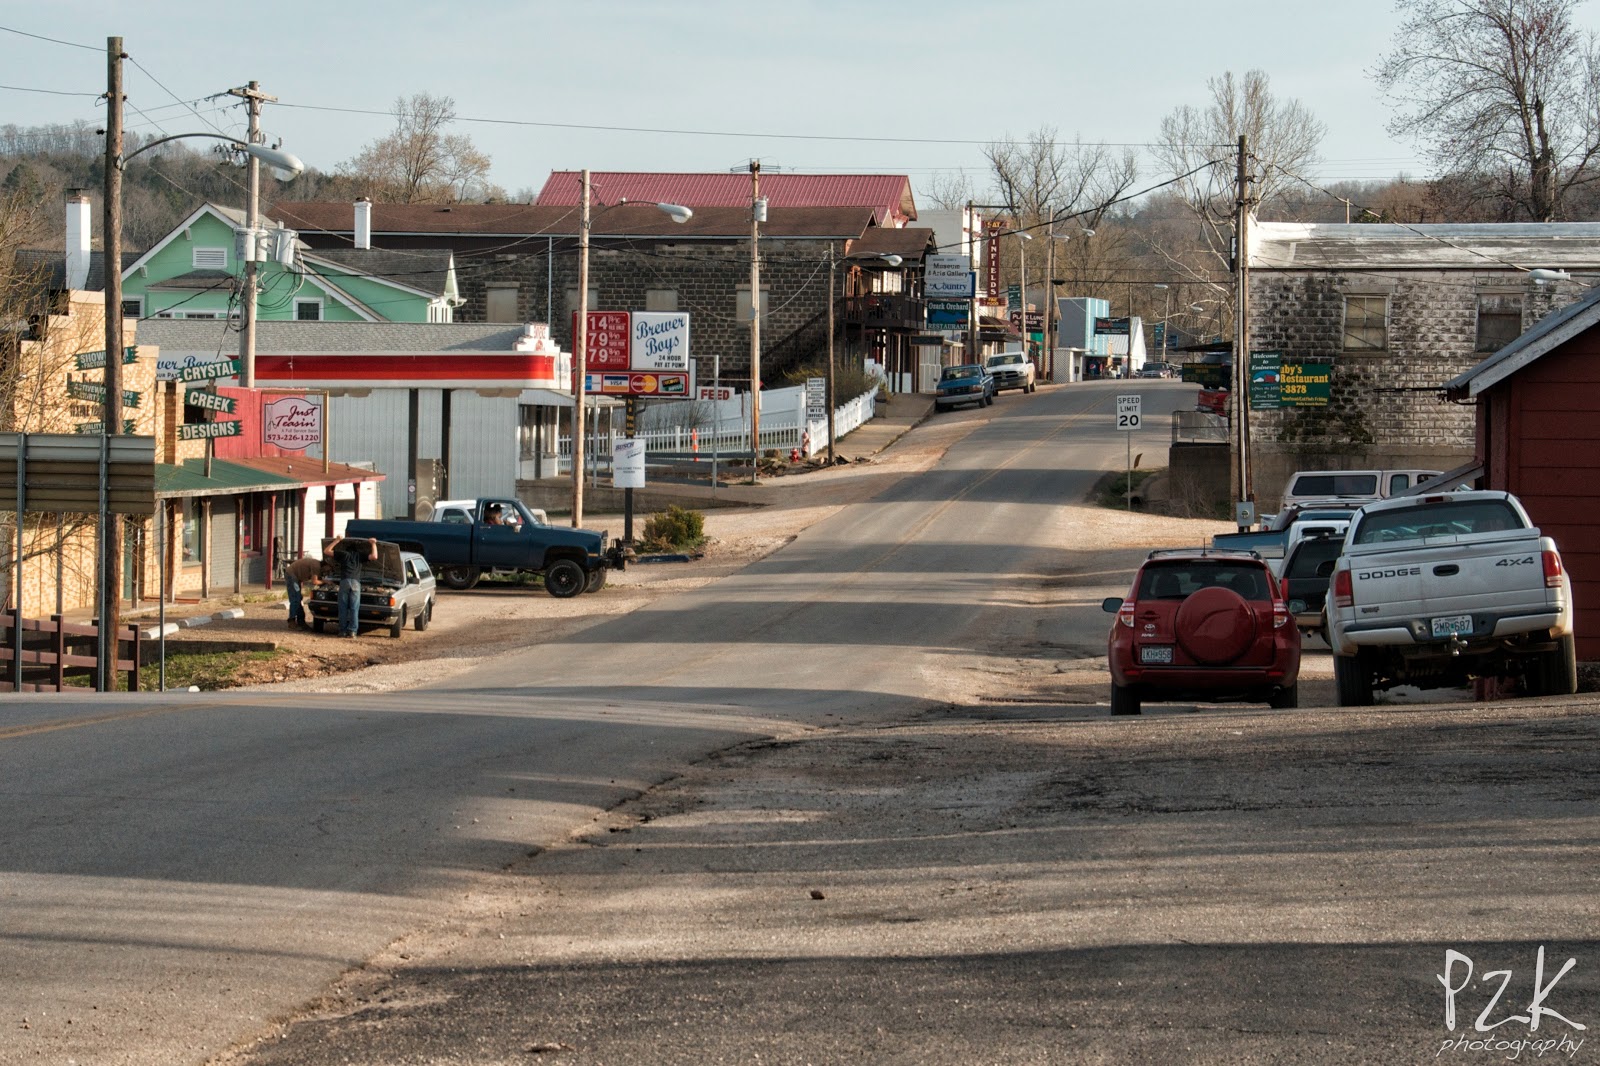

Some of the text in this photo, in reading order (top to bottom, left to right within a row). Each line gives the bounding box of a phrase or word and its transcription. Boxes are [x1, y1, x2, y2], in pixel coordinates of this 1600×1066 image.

[990, 230, 998, 295] WINFIELDS
[636, 317, 685, 340] Brewer
[588, 332, 608, 347] 79
[645, 336, 680, 356] Boys
[588, 348, 608, 363] 79
[183, 362, 237, 381] CRYSTAL
[1280, 374, 1328, 383] Restaurant
[189, 391, 231, 412] CREEK
[701, 389, 730, 400] FEED
[288, 405, 318, 421] Just
[1119, 415, 1139, 426] 20
[276, 415, 316, 427] Teasin'
[182, 422, 235, 439] DESIGNS
[1359, 567, 1421, 580] DODGE
